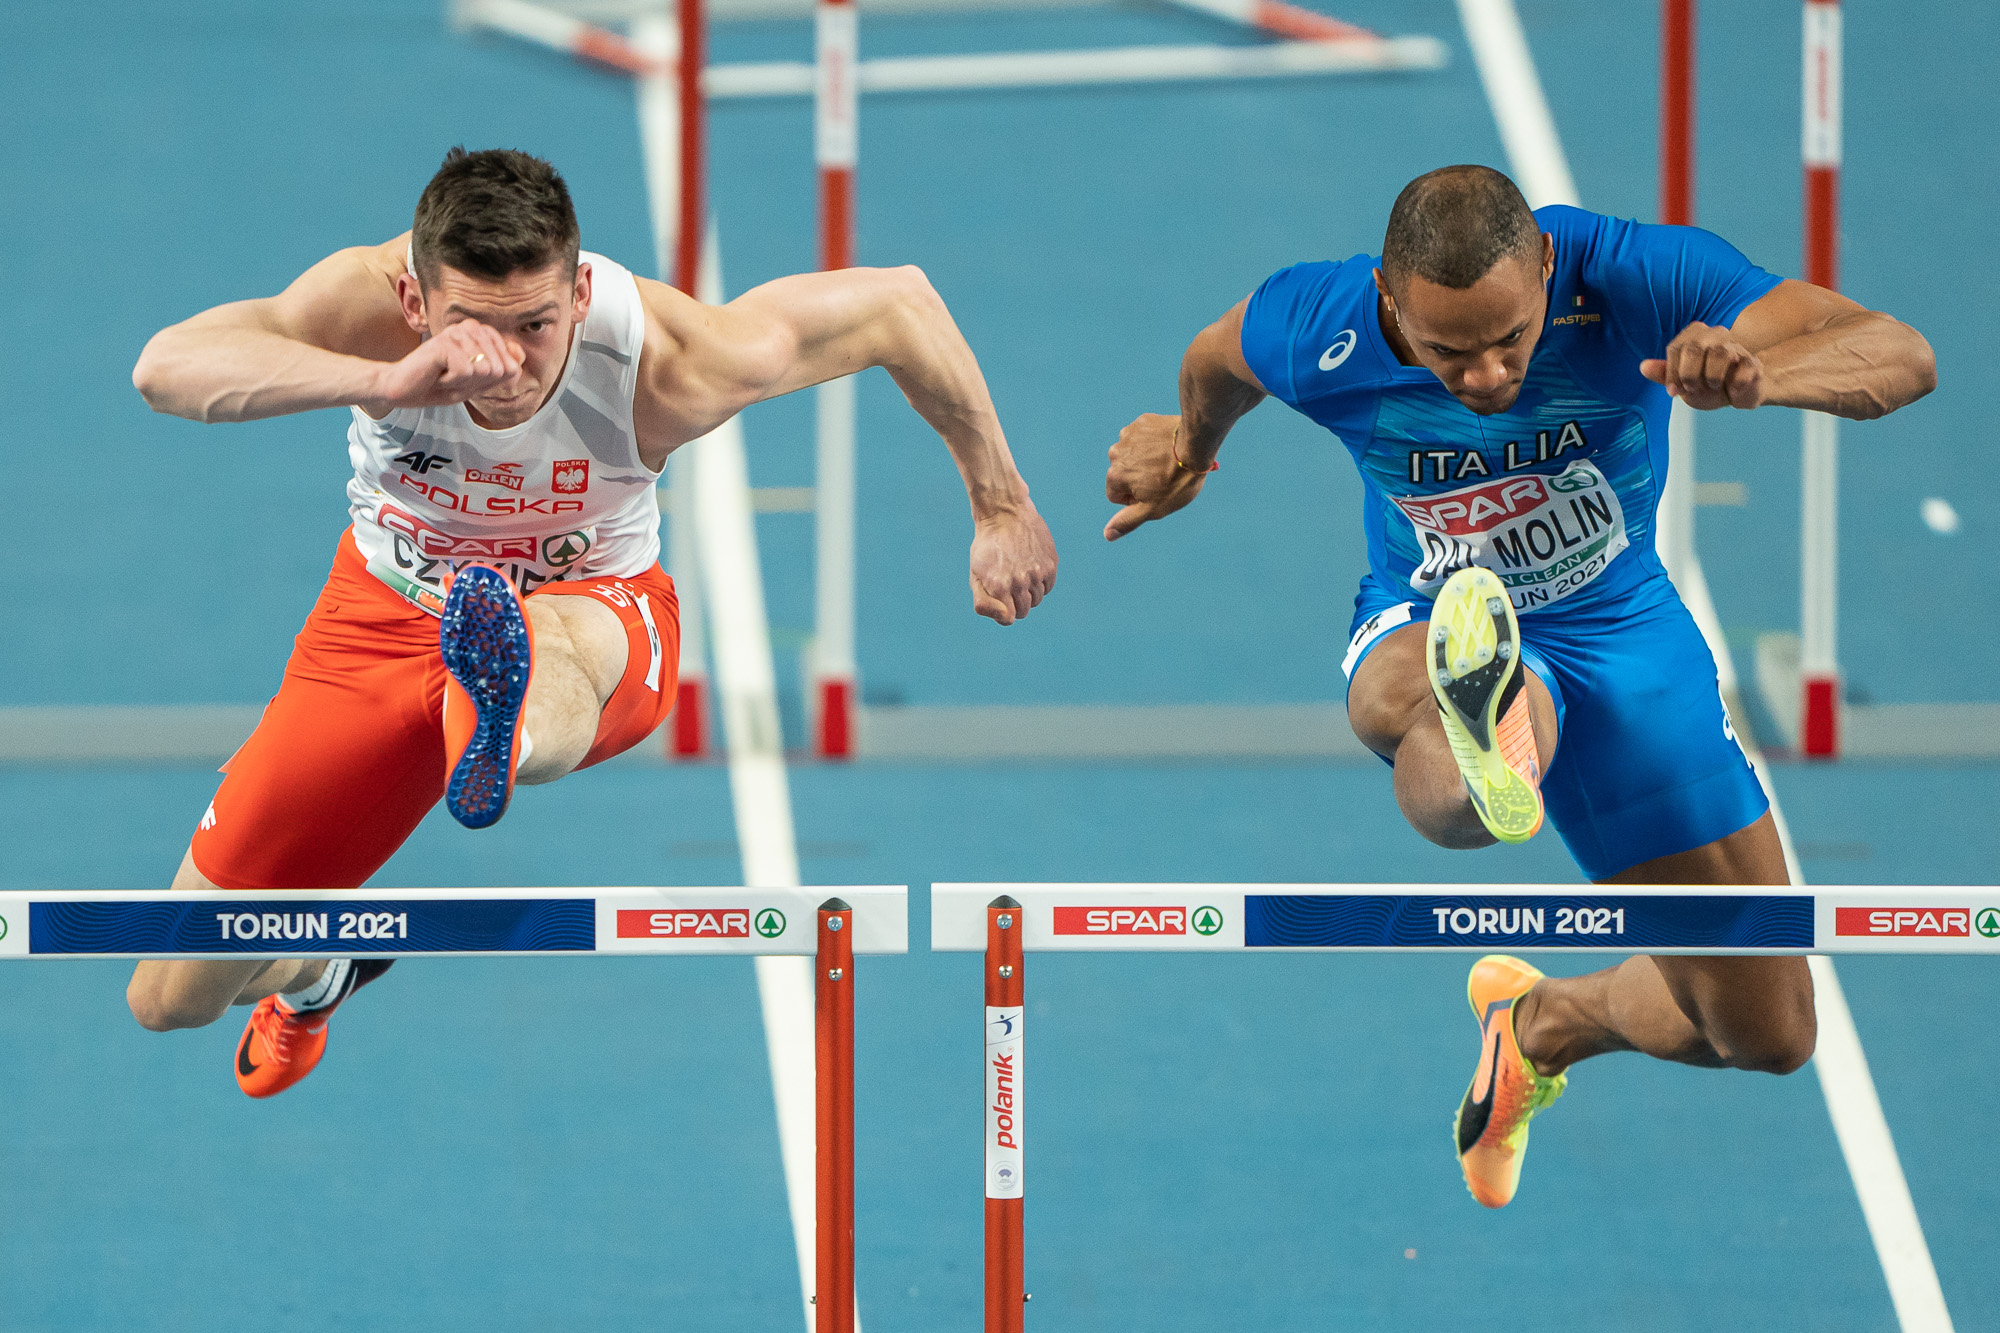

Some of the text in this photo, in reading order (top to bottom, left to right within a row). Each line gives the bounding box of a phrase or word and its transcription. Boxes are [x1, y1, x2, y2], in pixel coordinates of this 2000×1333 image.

[555, 460, 587, 468] POLSKA
[468, 470, 521, 489] ORLEN
[400, 473, 584, 517] POLSKA
[1400, 479, 1543, 531] SPAR
[1492, 490, 1614, 569] MOLIN
[1555, 553, 1606, 596] 2021
[216, 912, 408, 941] TORUN 2021
[649, 912, 748, 935] SPAR
[1086, 910, 1184, 932] SPAR
[1433, 907, 1625, 935] TORUN 2021
[1868, 911, 1968, 933] SPAR
[992, 1052, 1018, 1150] polanik
